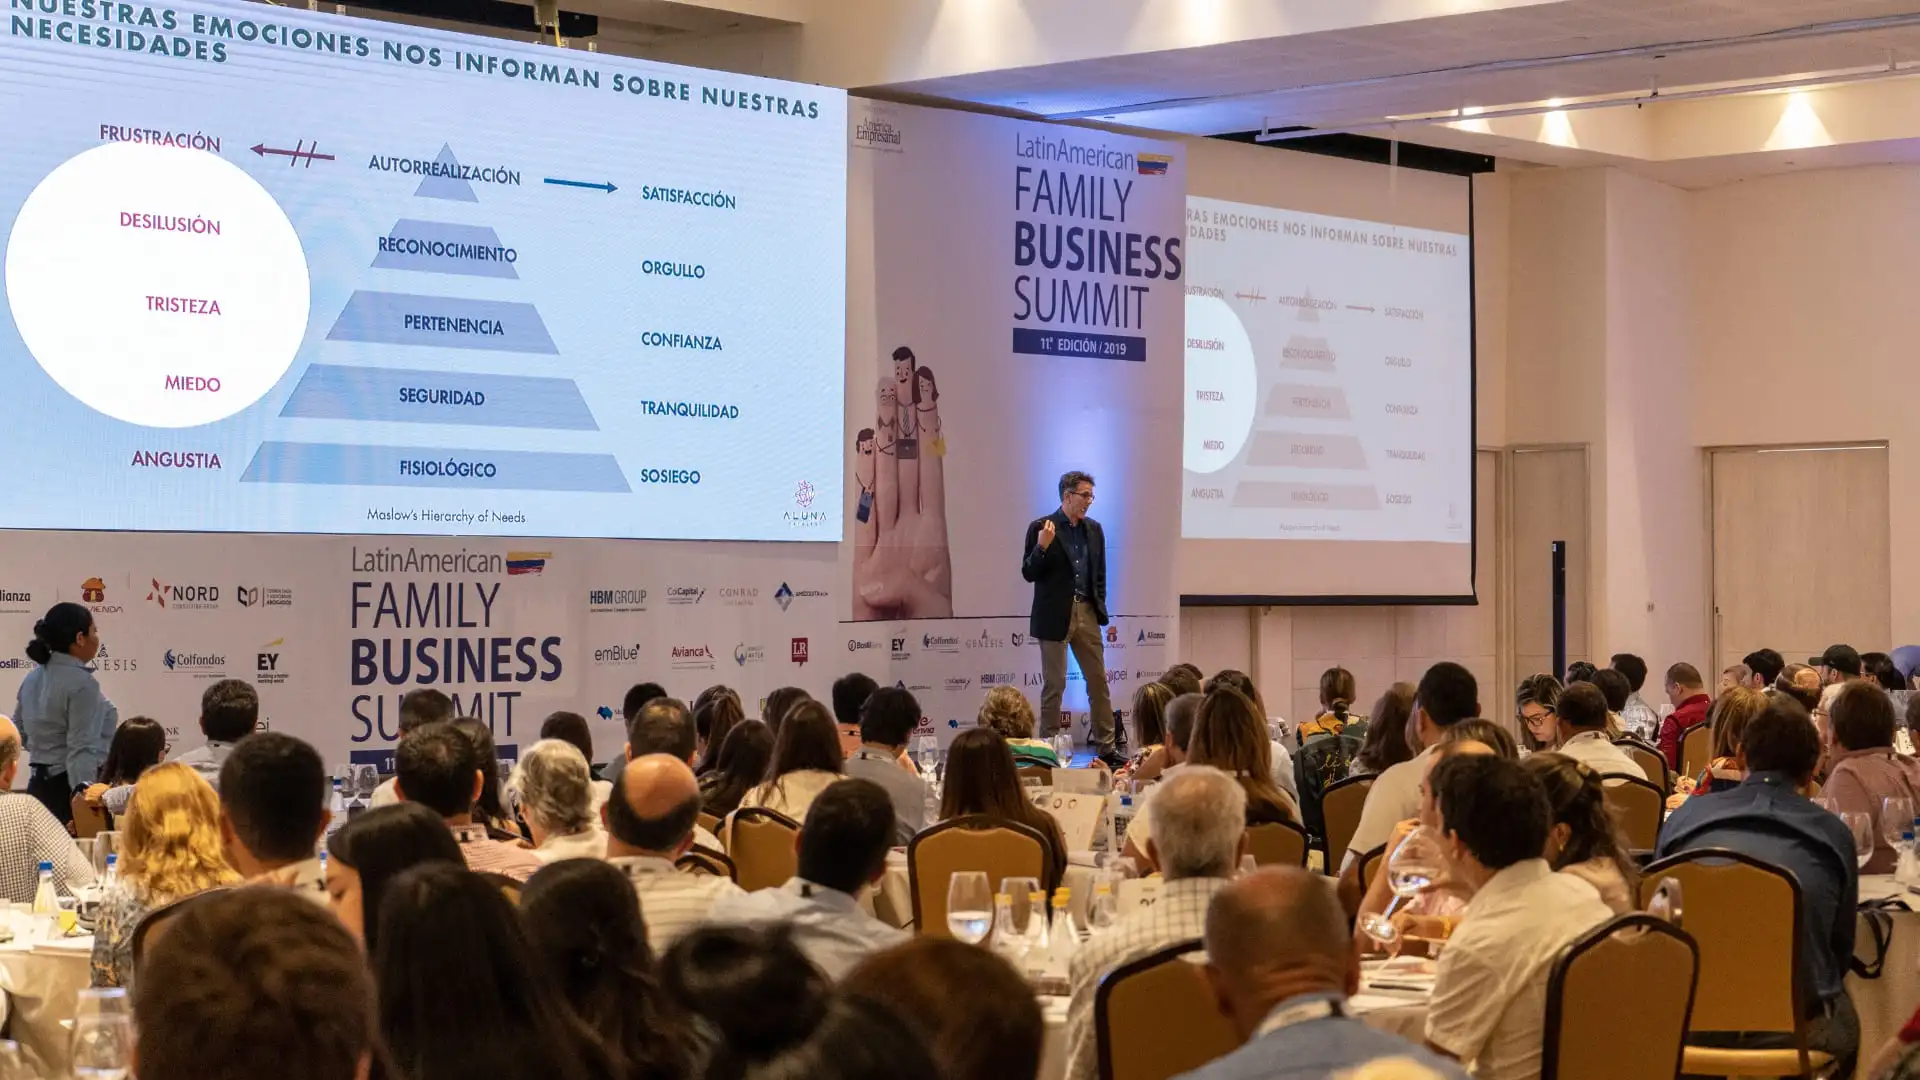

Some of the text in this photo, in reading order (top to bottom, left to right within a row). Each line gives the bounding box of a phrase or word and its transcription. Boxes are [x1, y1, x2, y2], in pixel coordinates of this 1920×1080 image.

[11, 15, 228, 63] NECESIDADES
[193, 14, 369, 57] EMOCIONES
[383, 42, 442, 67] NOS
[455, 51, 600, 89] INFORMAN
[613, 74, 690, 101] SOBRE
[702, 86, 819, 119] NUESTRAS
[100, 124, 220, 152] FRUSTRACIÓN
[1016, 133, 1134, 172] LatinAmerican
[368, 154, 521, 186] AUTORREALIZACIÓN
[642, 184, 736, 209] SATISFACCIÓN
[1016, 166, 1133, 222] FAMILY
[120, 211, 220, 235] DESILUSIÓN
[1213, 211, 1278, 233] EMOCIONES
[1283, 222, 1307, 237] NOS
[1311, 226, 1368, 245] INFORMAN
[1372, 234, 1404, 250] SOBRE
[1408, 239, 1457, 257] NUESTRAS
[378, 236, 518, 263] RECONOCIMIENTO
[1015, 221, 1182, 281] BUSINESS
[642, 260, 706, 279] ORGULLO
[146, 296, 221, 315] TRISTEZA
[1014, 275, 1149, 329] SUMMIT
[404, 314, 505, 336] PERTENENCIA
[641, 332, 722, 351] CONFIANZA
[1104, 342, 1127, 355] 2019
[1187, 339, 1224, 351] DESILUSIÓN
[165, 375, 221, 392] MIEDO
[399, 387, 485, 406] SEGURIDAD
[1196, 390, 1224, 402] TRISTEZA
[641, 400, 739, 419] TRANQUILIDAD
[1203, 440, 1224, 450] MIEDO
[131, 450, 221, 469] ANGUSTIA
[400, 457, 497, 478] FISIOLÓGICO
[641, 469, 700, 484] SOSIEGO
[1191, 487, 1224, 499] ANGUSTIA
[367, 508, 526, 525] Maslow's Hierarchy of Needs
[783, 512, 827, 520] ALUNA
[352, 547, 501, 573] LatinAmerican
[173, 586, 219, 601] NORD
[351, 582, 500, 628] FAMILY
[595, 645, 637, 661] emBlue
[672, 646, 704, 657] Avianca
[793, 642, 806, 655] LR
[892, 639, 905, 650] EY
[965, 639, 1005, 649] GENESIS
[177, 654, 225, 666] Colfondos
[257, 653, 279, 670] EY
[351, 636, 562, 685] BUSINESS
[351, 692, 521, 742] SUMIT
